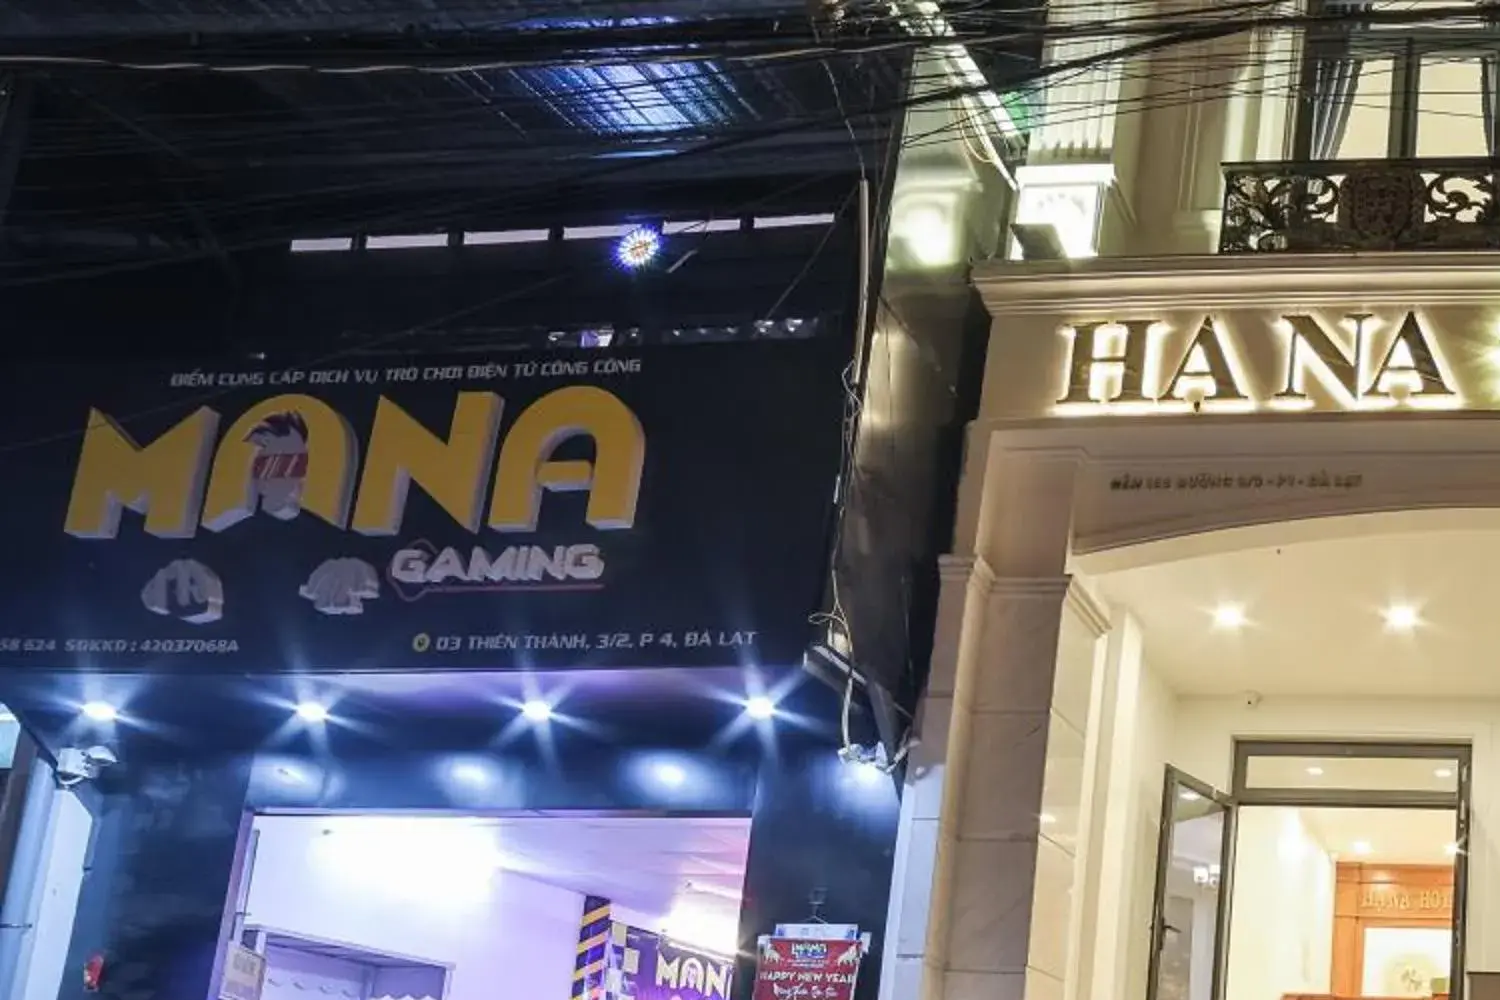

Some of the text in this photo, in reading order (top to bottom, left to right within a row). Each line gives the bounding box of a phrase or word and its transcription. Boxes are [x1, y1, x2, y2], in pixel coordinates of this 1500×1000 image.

[218, 371, 265, 386] CUNG
[63, 386, 646, 539] MANA
[391, 543, 605, 584] GAMING
[436, 636, 462, 651] 03
[760, 970, 797, 983] HAPPY
[798, 971, 822, 983] NEW
